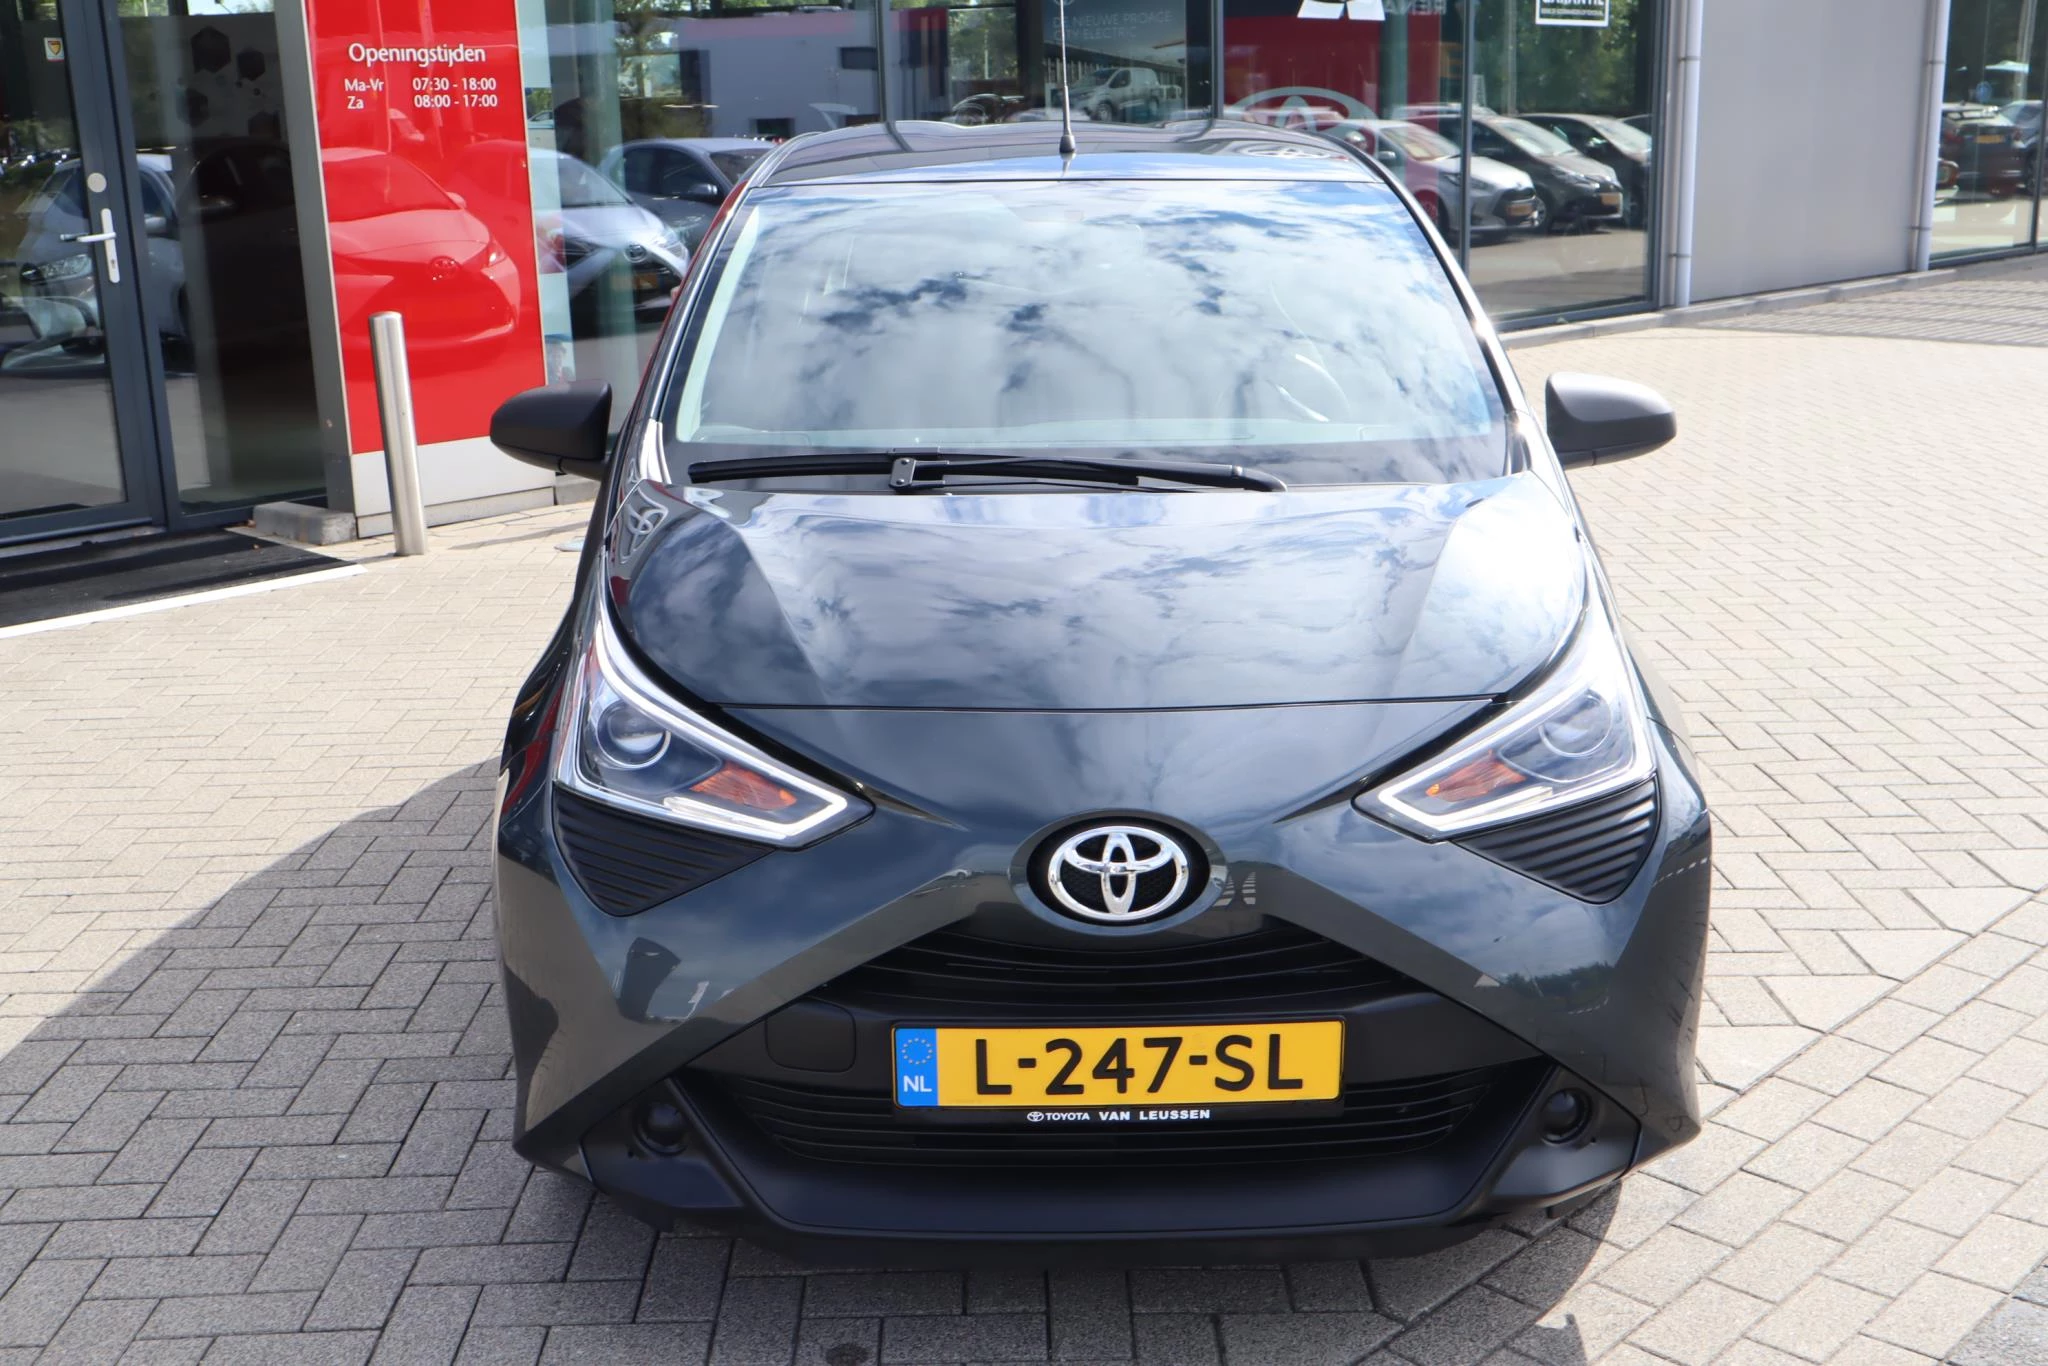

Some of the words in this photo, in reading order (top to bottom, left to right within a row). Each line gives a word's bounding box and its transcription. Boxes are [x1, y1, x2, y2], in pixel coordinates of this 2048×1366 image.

[1052, 28, 1079, 41] CTY
[348, 42, 486, 67] Openingstijden
[344, 78, 384, 92] Ma-Vr
[412, 77, 449, 91] 07:30
[461, 77, 497, 91] 18:00
[347, 95, 364, 109] Za
[414, 94, 451, 108] 08:00
[463, 94, 498, 108] 17:00
[903, 1075, 932, 1093] NL
[975, 1033, 1303, 1096] L-247-SL
[1047, 1111, 1090, 1121] TOYOTA
[1099, 1111, 1130, 1121] VAN
[1139, 1109, 1210, 1120] LEUSSEN
